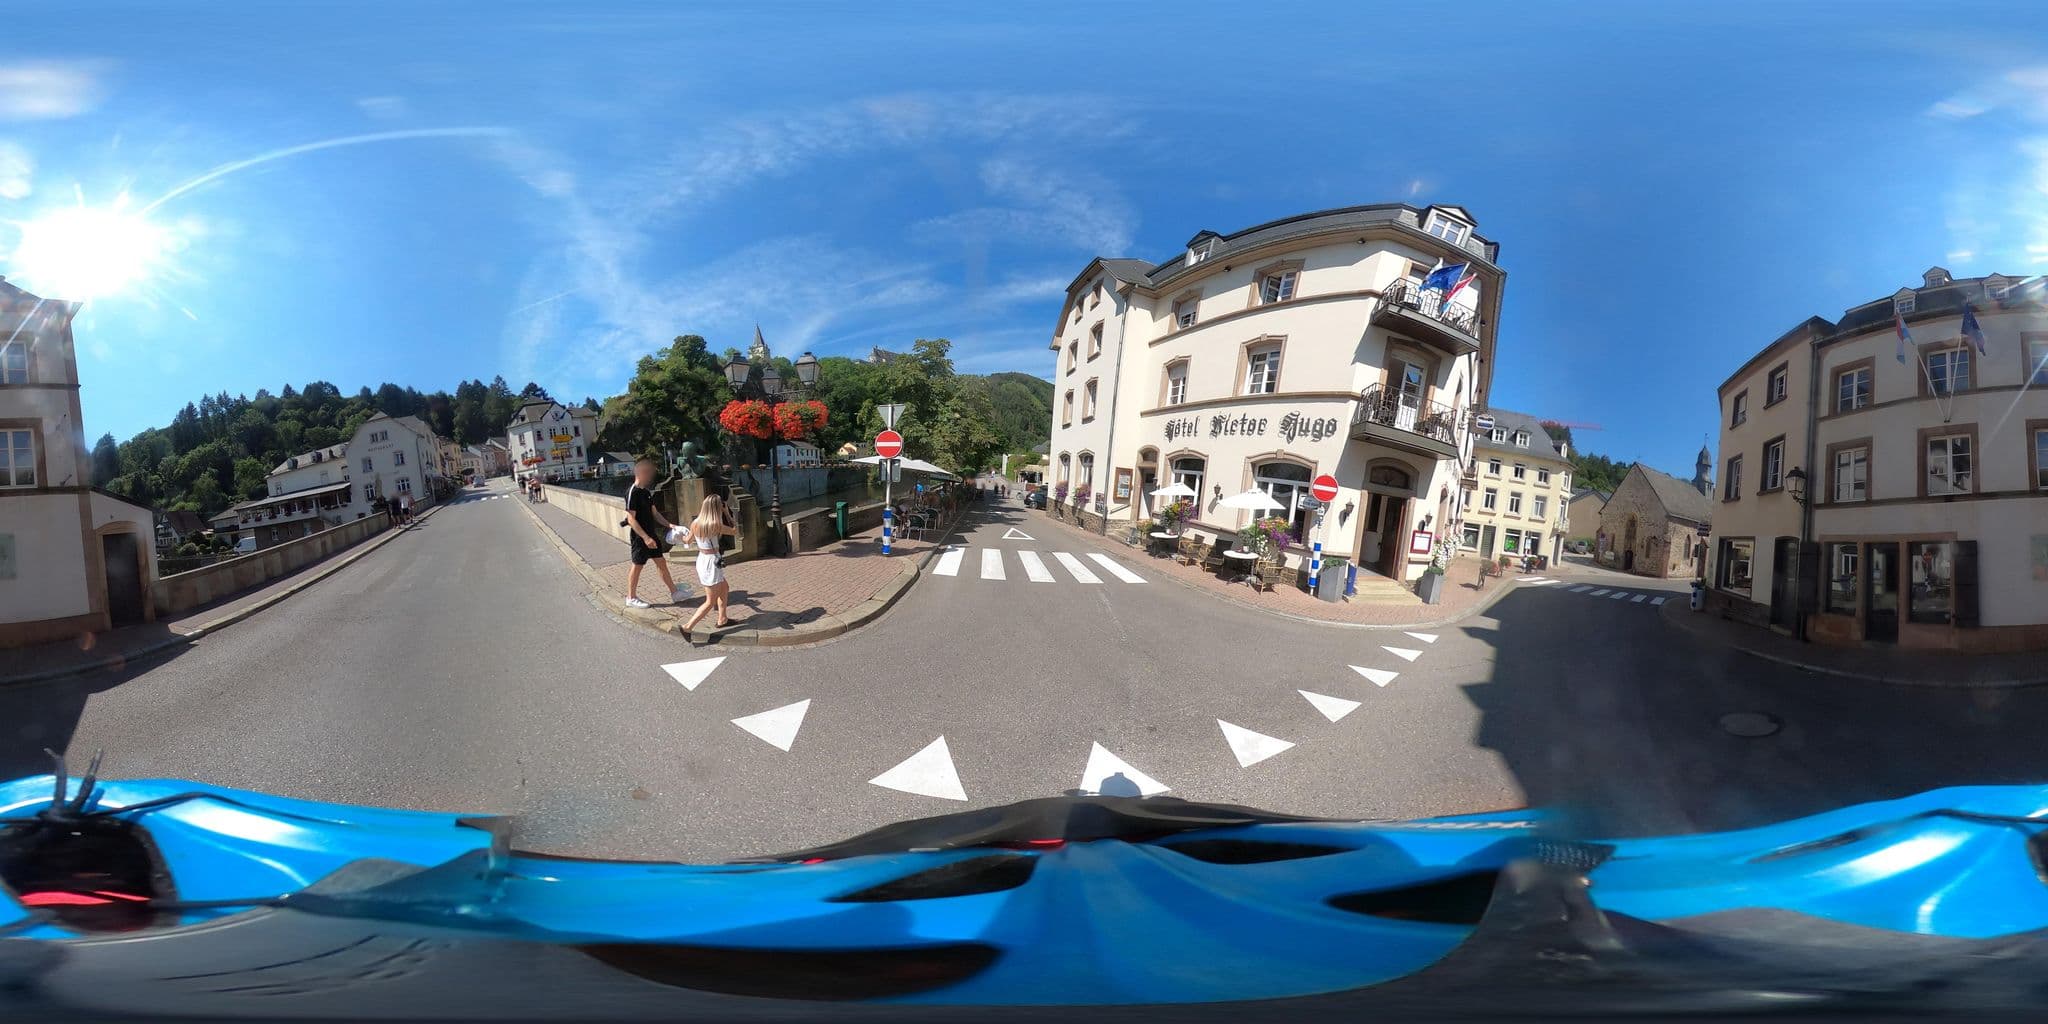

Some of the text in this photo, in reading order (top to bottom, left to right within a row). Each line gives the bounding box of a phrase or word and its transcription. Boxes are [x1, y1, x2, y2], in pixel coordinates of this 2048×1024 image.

[1165, 411, 1338, 444] Hôtel Victor Hugo
